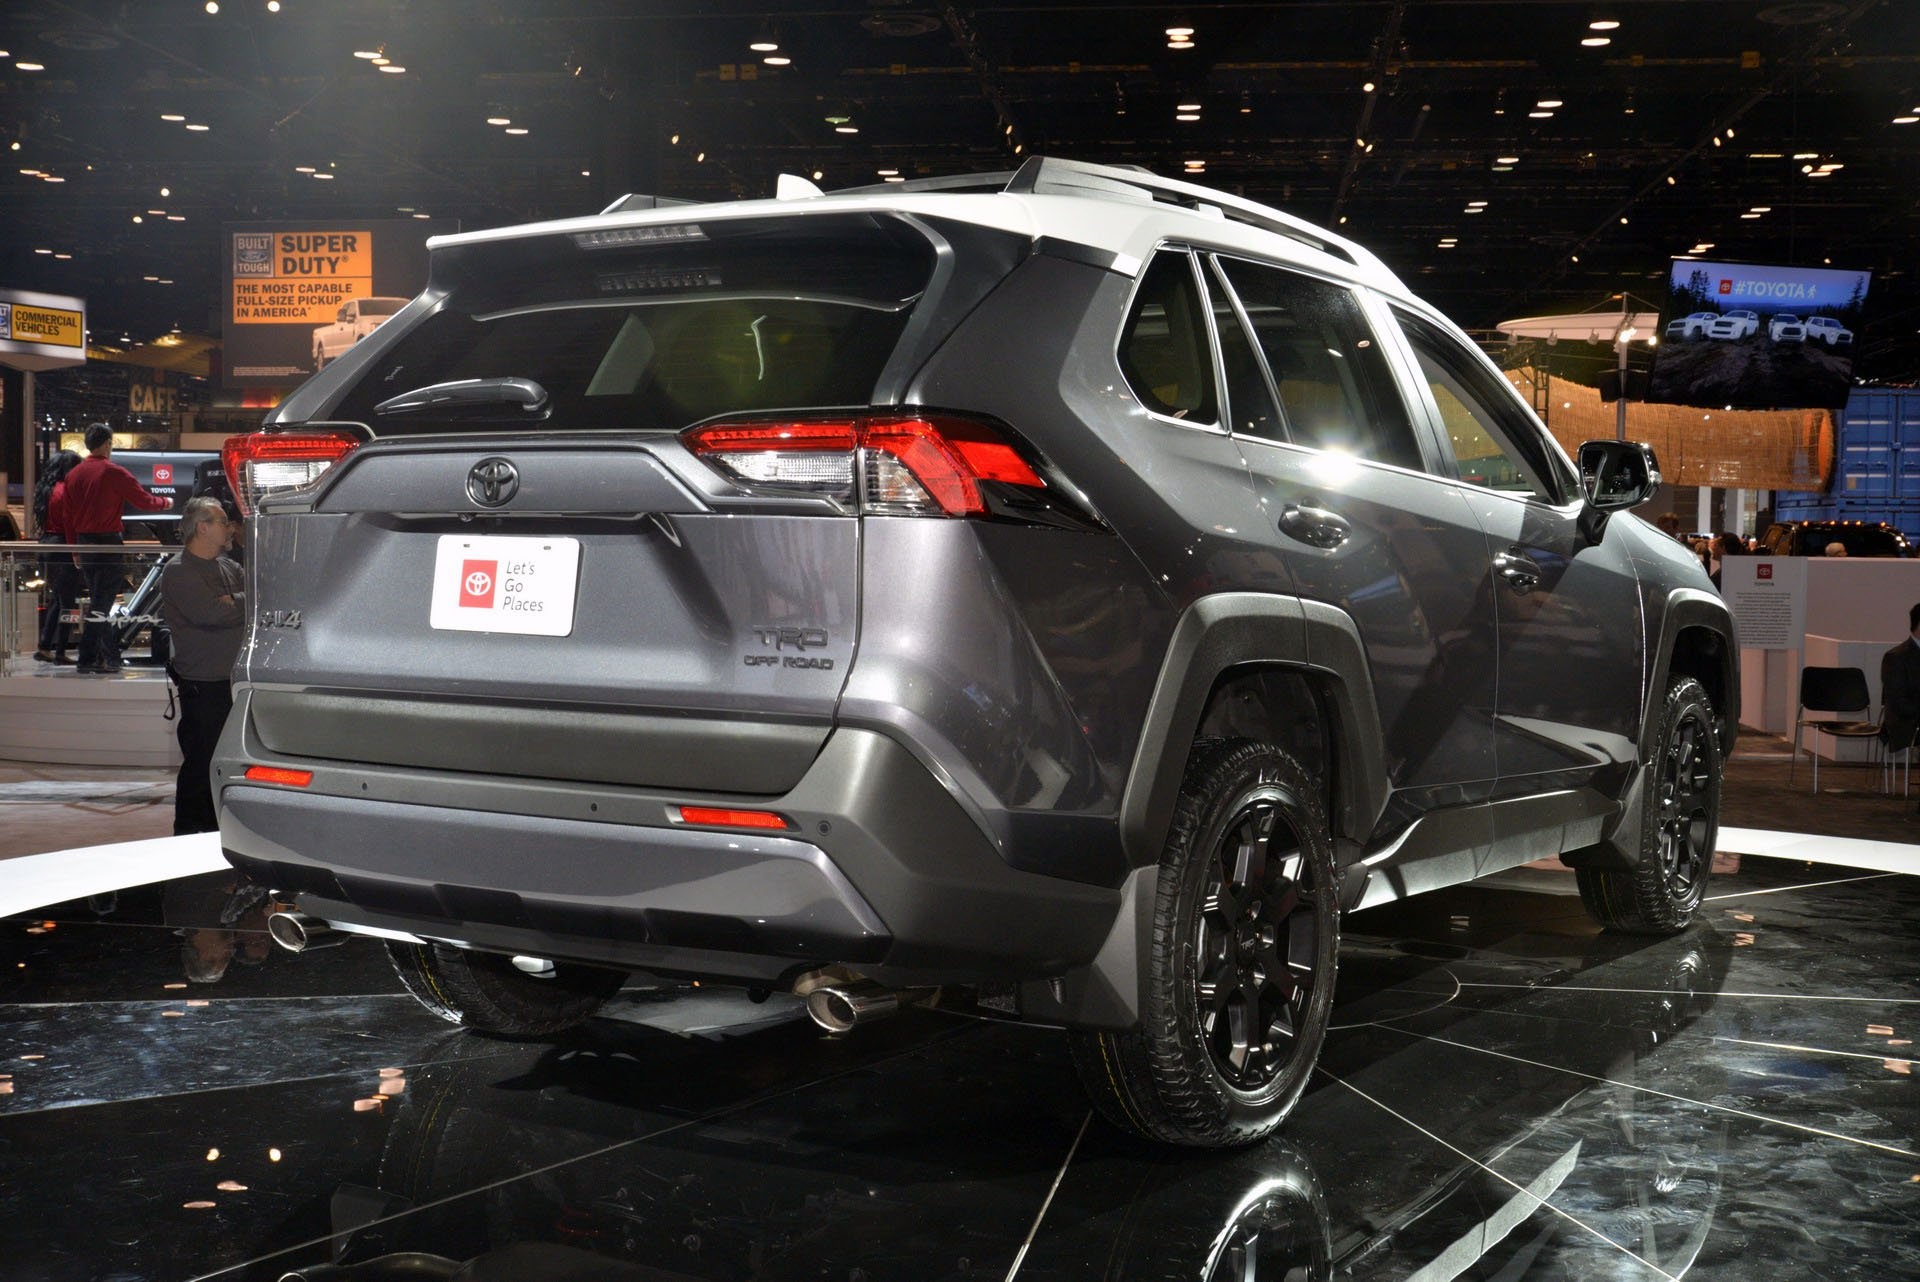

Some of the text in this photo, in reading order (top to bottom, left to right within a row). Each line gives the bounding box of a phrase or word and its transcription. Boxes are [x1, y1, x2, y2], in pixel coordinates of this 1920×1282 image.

[238, 237, 269, 250] BUILT
[281, 234, 358, 254] SUPER
[238, 262, 270, 273] TOUGH
[236, 283, 353, 294] THE MOST CAPABLE
[1735, 280, 1805, 298] #TOYOTA
[236, 295, 342, 306] FULL-SIZE PICKUP
[15, 310, 78, 328] COMMERCIAL
[236, 307, 249, 318] IN
[15, 321, 60, 336] VEHICLES
[506, 560, 535, 575] Let's
[504, 578, 524, 592] Go
[502, 596, 544, 612] Places
[84, 610, 164, 629] Supra
[752, 625, 829, 651] TRD
[744, 655, 834, 670] OFF ROAD
